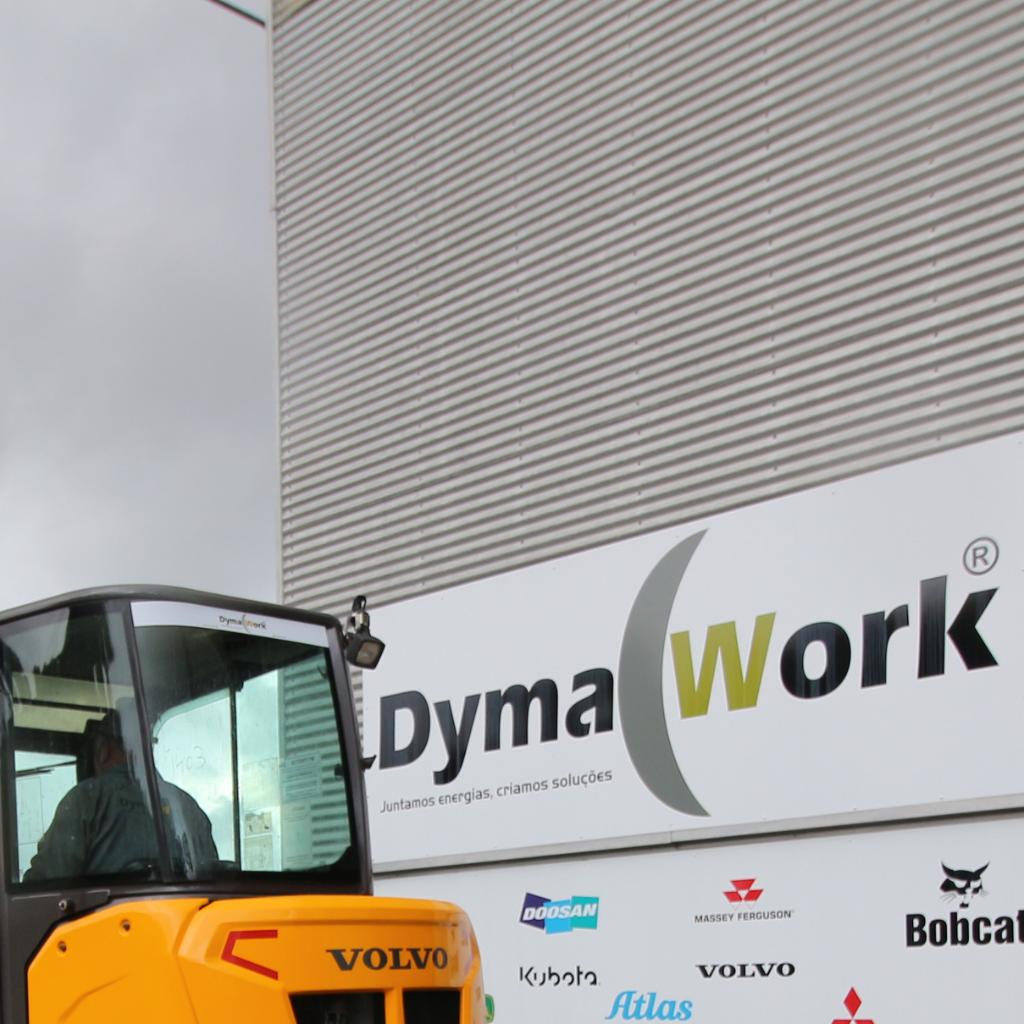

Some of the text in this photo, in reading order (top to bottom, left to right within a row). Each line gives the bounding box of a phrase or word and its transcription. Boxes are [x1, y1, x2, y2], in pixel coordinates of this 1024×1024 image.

[379, 574, 999, 786] Dyma Work
[380, 769, 613, 814] Juntamos energias, criamos soluções
[522, 903, 598, 921] DOOSAN
[694, 910, 792, 924] MASSEY FERGUSON
[906, 910, 1024, 947] Bobcat
[326, 947, 448, 971] VOLVO
[695, 962, 796, 979] VOLVO
[519, 965, 598, 987] Kubota
[604, 990, 693, 1021] Atlas
